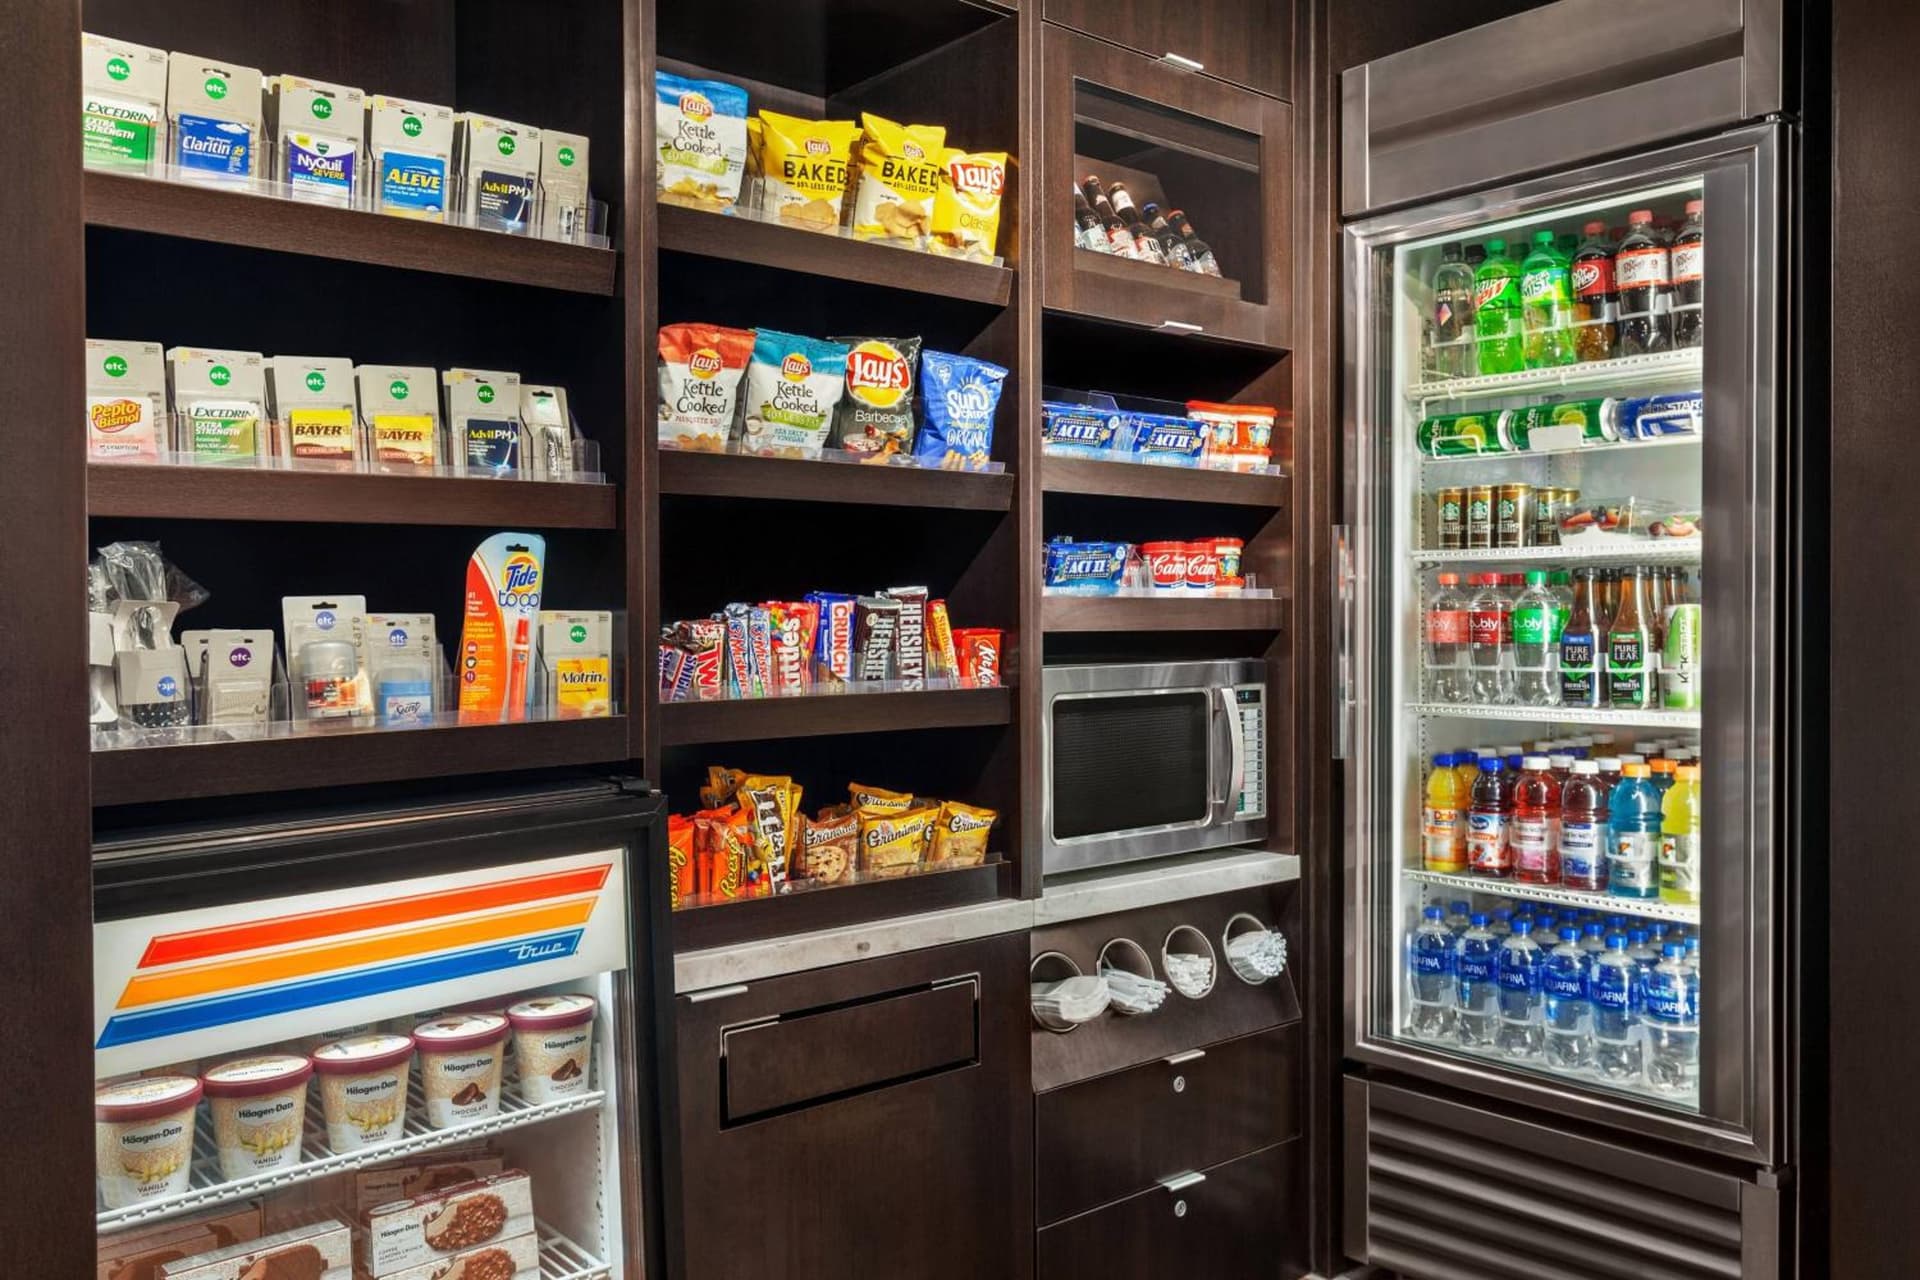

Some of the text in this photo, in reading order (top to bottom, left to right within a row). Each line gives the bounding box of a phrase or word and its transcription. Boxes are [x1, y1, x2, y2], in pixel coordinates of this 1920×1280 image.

[86, 101, 153, 122] EXCEDRIN
[678, 120, 715, 140] Kettle
[182, 135, 231, 156] Claritin
[673, 136, 722, 157] Cooked
[297, 153, 343, 172] NyQuil
[312, 168, 345, 180] SEVERE
[385, 168, 441, 189] ALEVE
[784, 160, 848, 186] BAKED
[882, 161, 939, 188] BAKED
[957, 163, 1003, 196] Lay's
[691, 354, 720, 371] Lay's
[785, 358, 811, 375] Lay's
[851, 352, 905, 388] Lay's
[683, 378, 724, 399] Kettle
[776, 380, 814, 399] Kettle
[92, 402, 140, 421] Pepto
[194, 407, 255, 418] EXCEDRIN
[676, 396, 727, 415] Cooked
[772, 396, 818, 414] Cooked
[99, 413, 140, 429] Bismol
[295, 424, 342, 436] BAYER
[507, 563, 539, 593] Tide
[499, 590, 519, 608] to
[833, 604, 850, 674] CRUNCH
[900, 603, 924, 692] HERSHEY'S
[1614, 644, 1638, 652] PURE
[1566, 653, 1589, 661] LEAF
[1614, 652, 1638, 660] LEAF
[561, 670, 603, 685] Motrin
[238, 1101, 294, 1119] Häagen-Dazs
[122, 1126, 183, 1146] Häagen-Dazs
[253, 1154, 283, 1166] VANILLA
[137, 1181, 169, 1193] VANILLA
